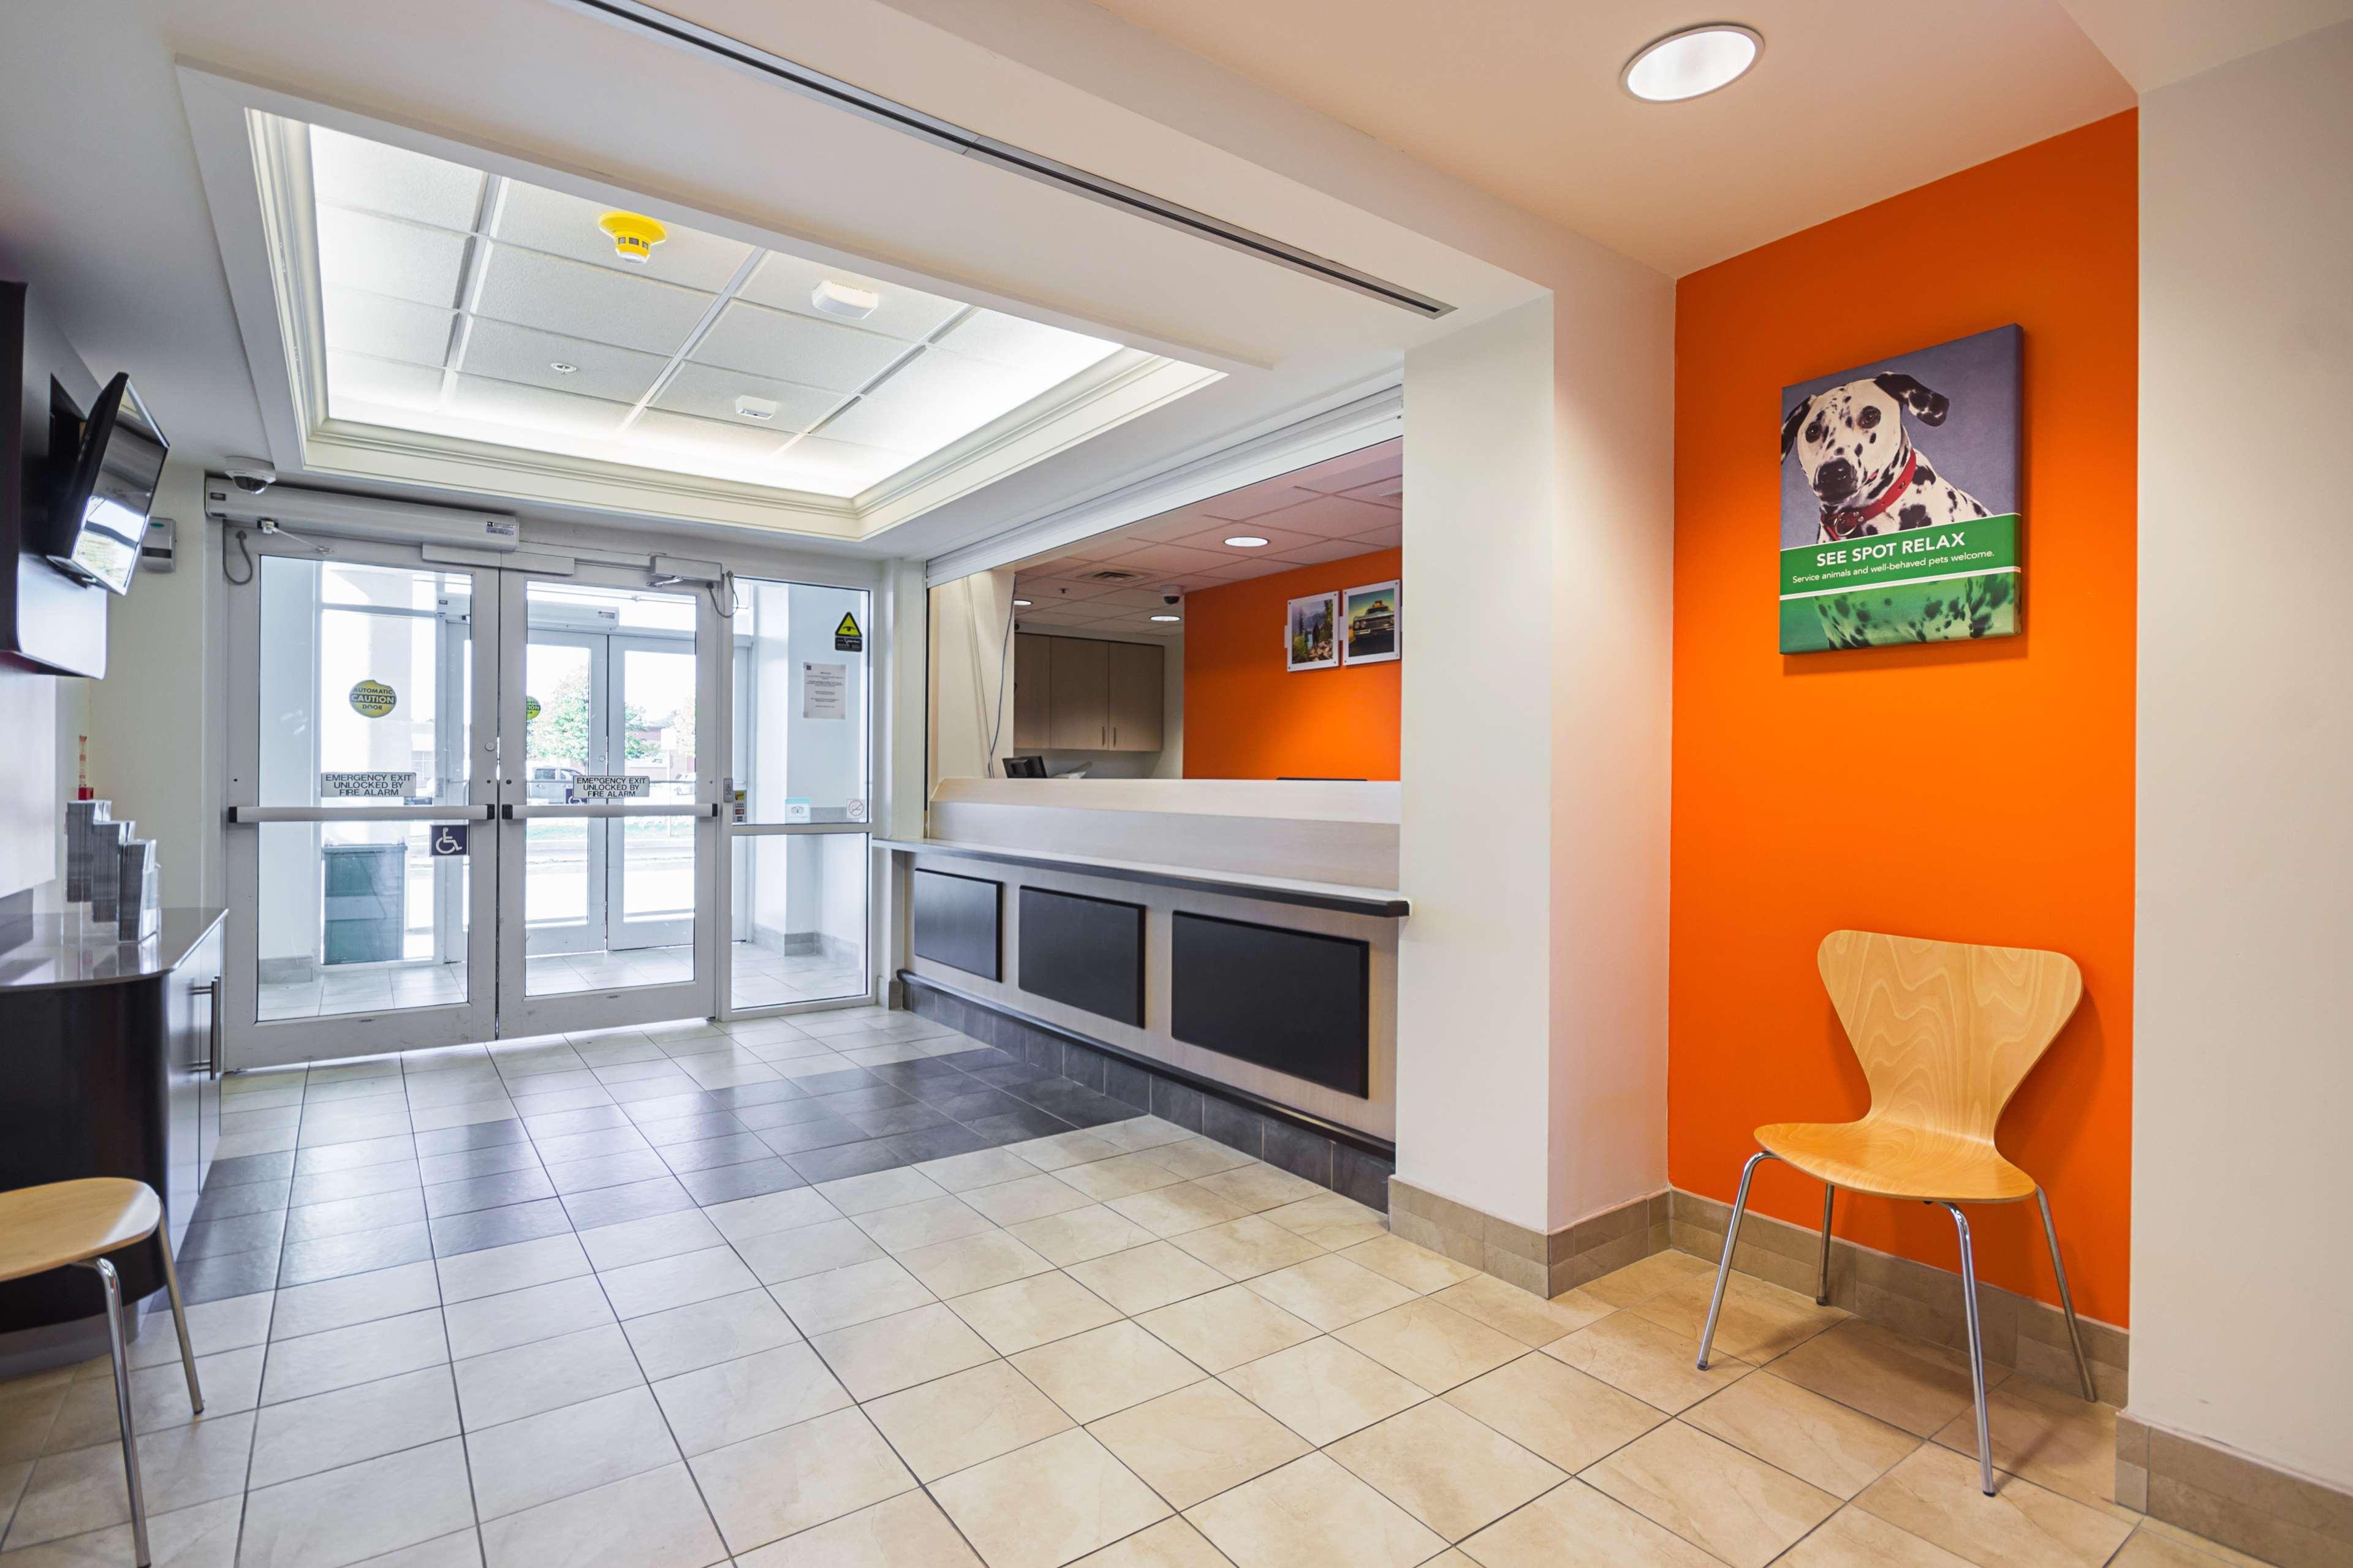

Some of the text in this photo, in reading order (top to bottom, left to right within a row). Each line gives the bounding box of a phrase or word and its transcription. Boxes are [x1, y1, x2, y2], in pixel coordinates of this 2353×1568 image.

[1816, 532, 1966, 567] SEE SPOT RELAX
[1792, 550, 1995, 583] Service animals and well-behaved pets welcome.
[351, 694, 395, 704] CAUTION
